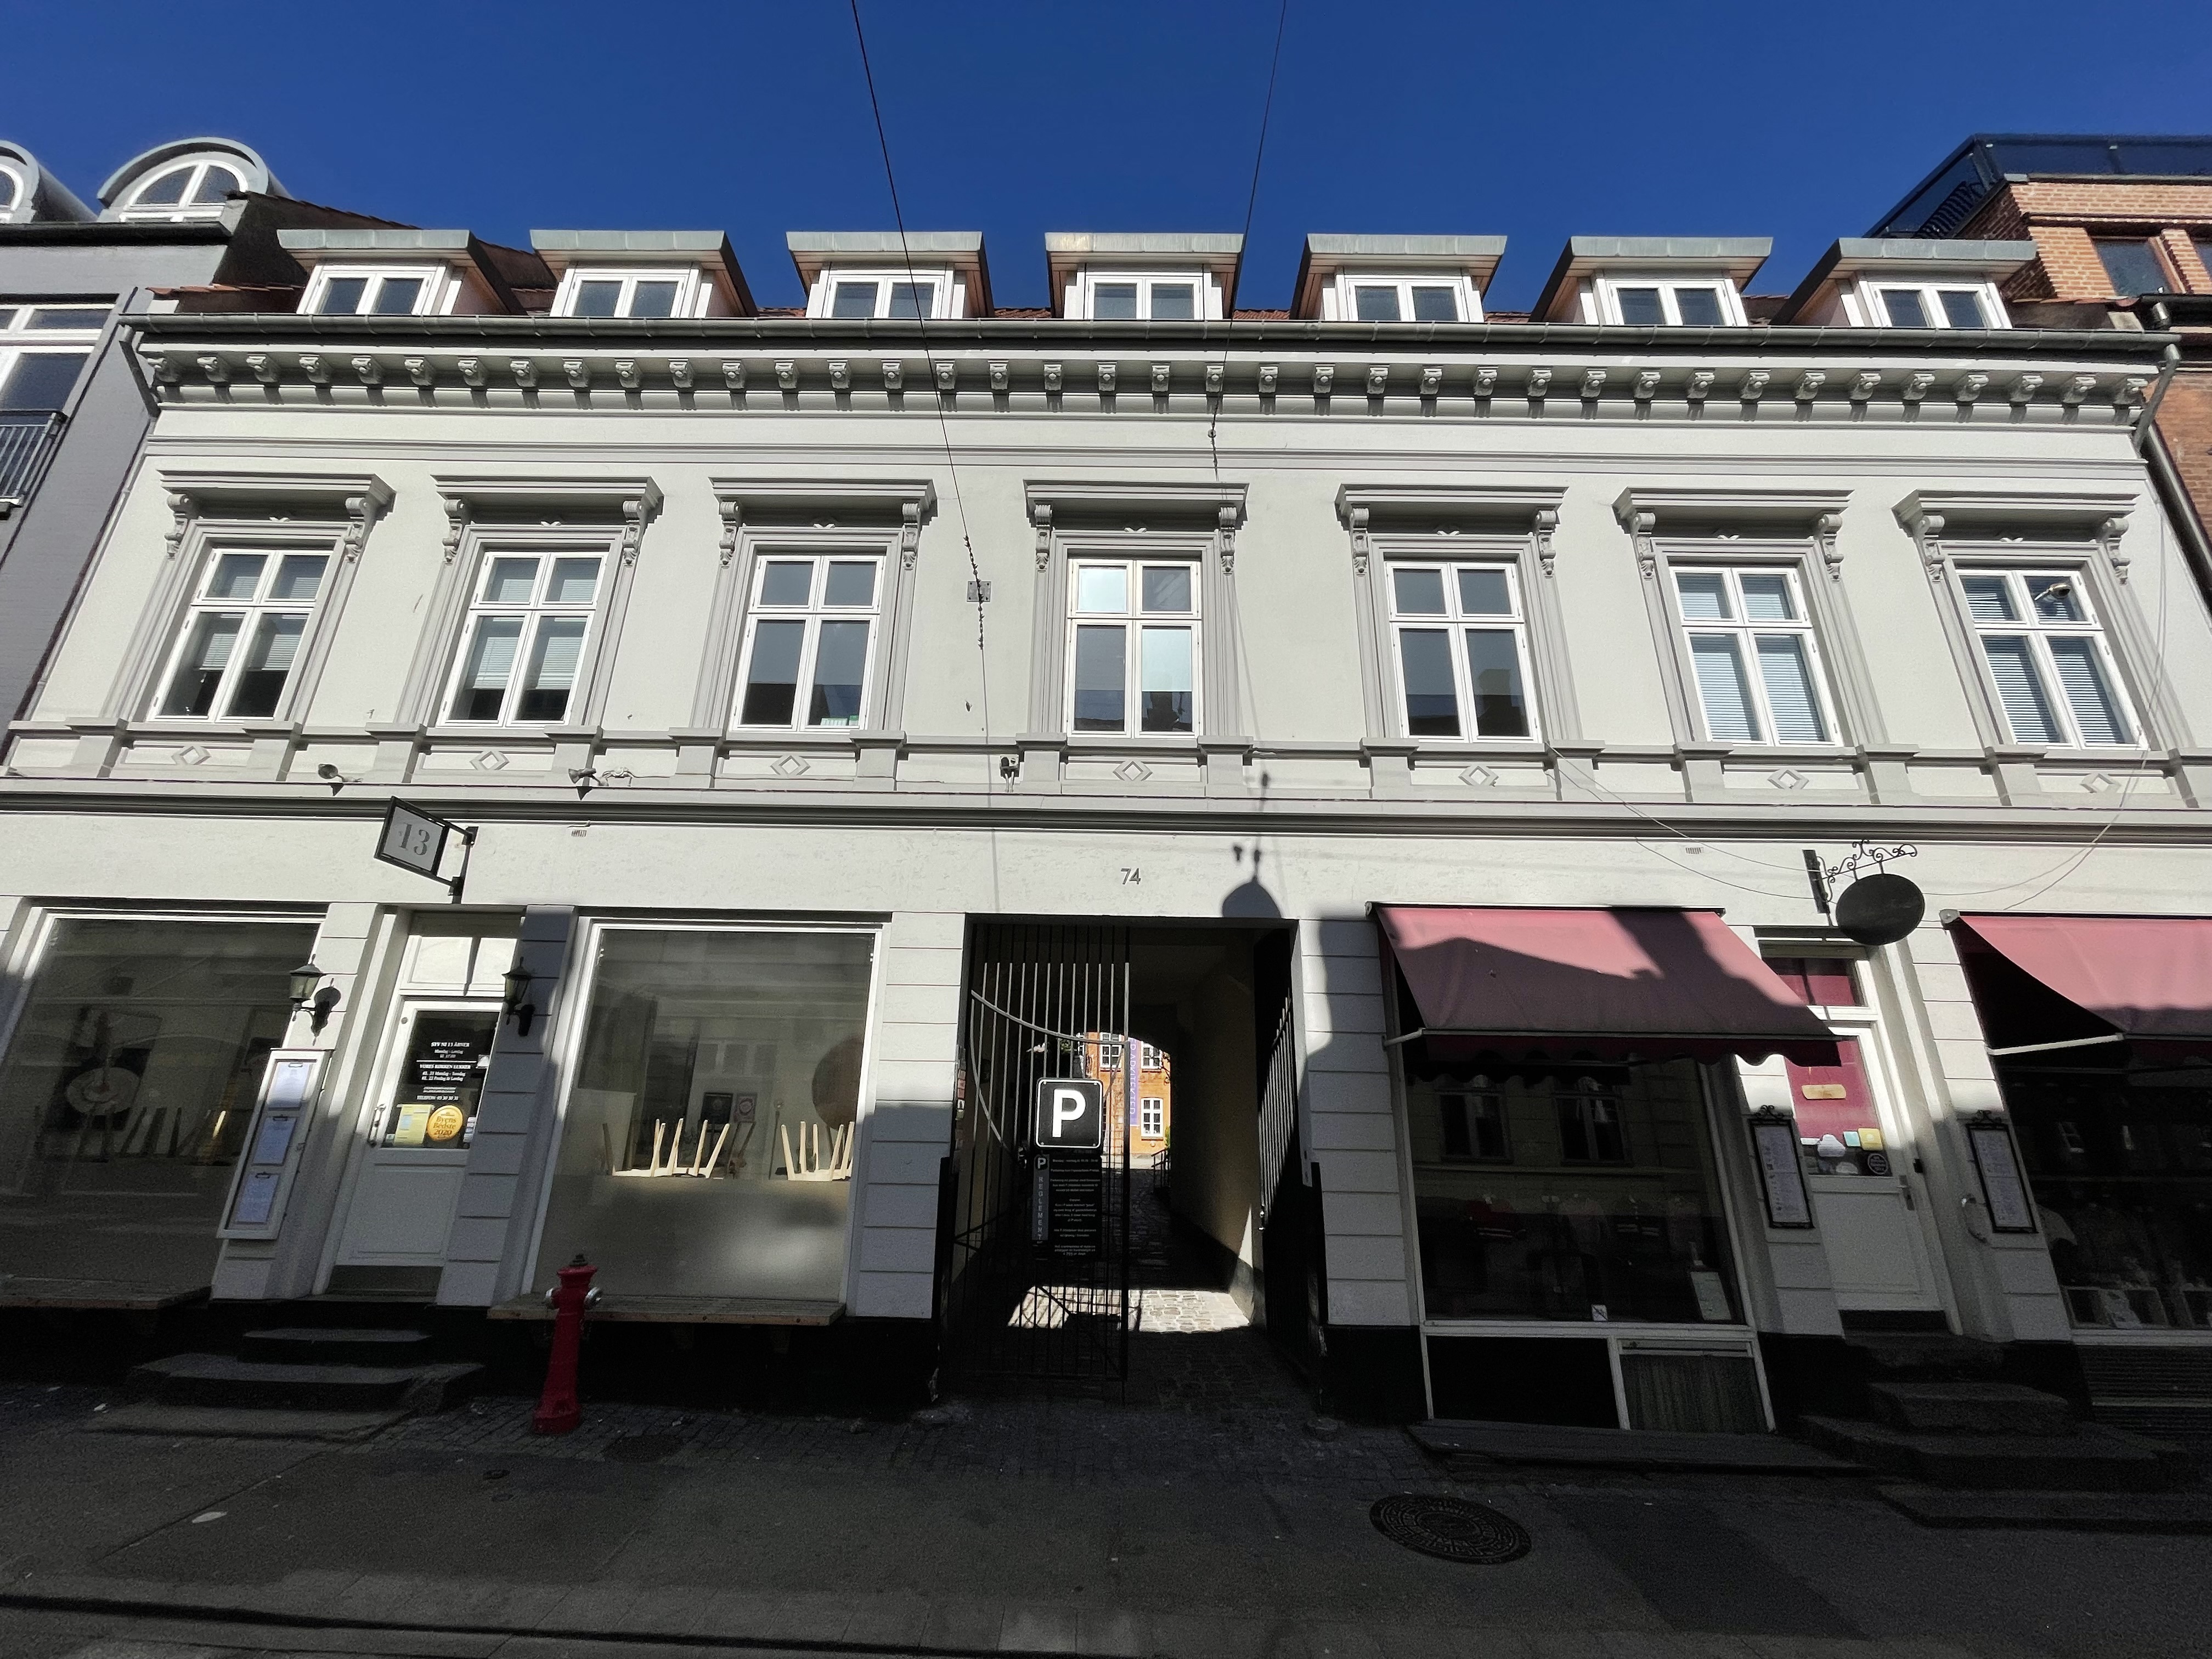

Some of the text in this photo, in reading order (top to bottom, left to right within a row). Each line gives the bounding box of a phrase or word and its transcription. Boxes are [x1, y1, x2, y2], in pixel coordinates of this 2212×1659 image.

[398, 823, 430, 856] 13
[1121, 868, 1141, 884] 74
[1052, 1088, 1086, 1138] P
[1037, 1157, 1046, 1169] P
